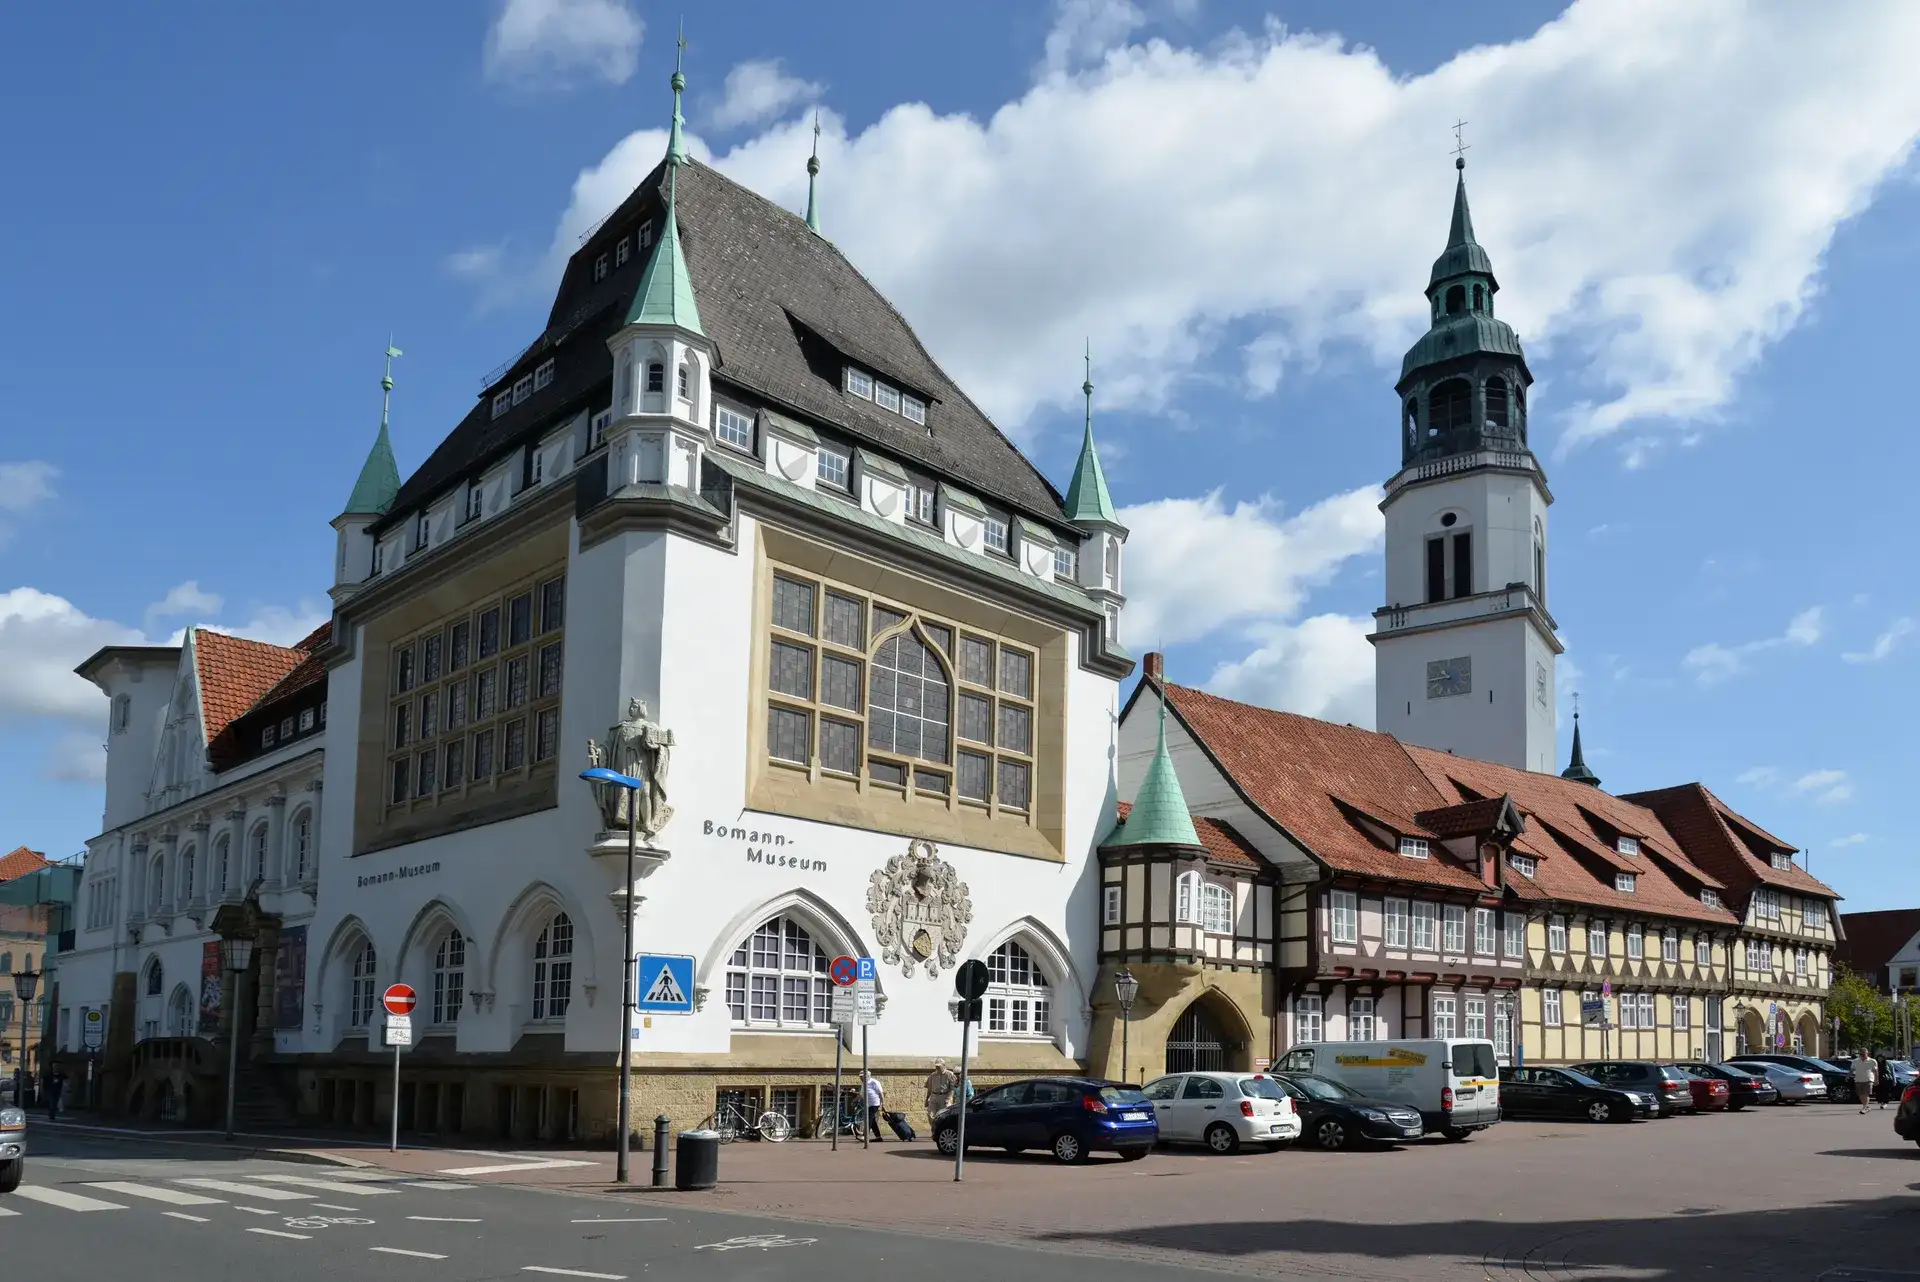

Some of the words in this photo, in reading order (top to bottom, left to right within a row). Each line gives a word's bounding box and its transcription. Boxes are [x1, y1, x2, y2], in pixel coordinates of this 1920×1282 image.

[703, 819, 795, 847] Bomann-
[746, 847, 827, 873] Museum
[357, 861, 441, 888] Bomann-Museum
[861, 960, 871, 978] P
